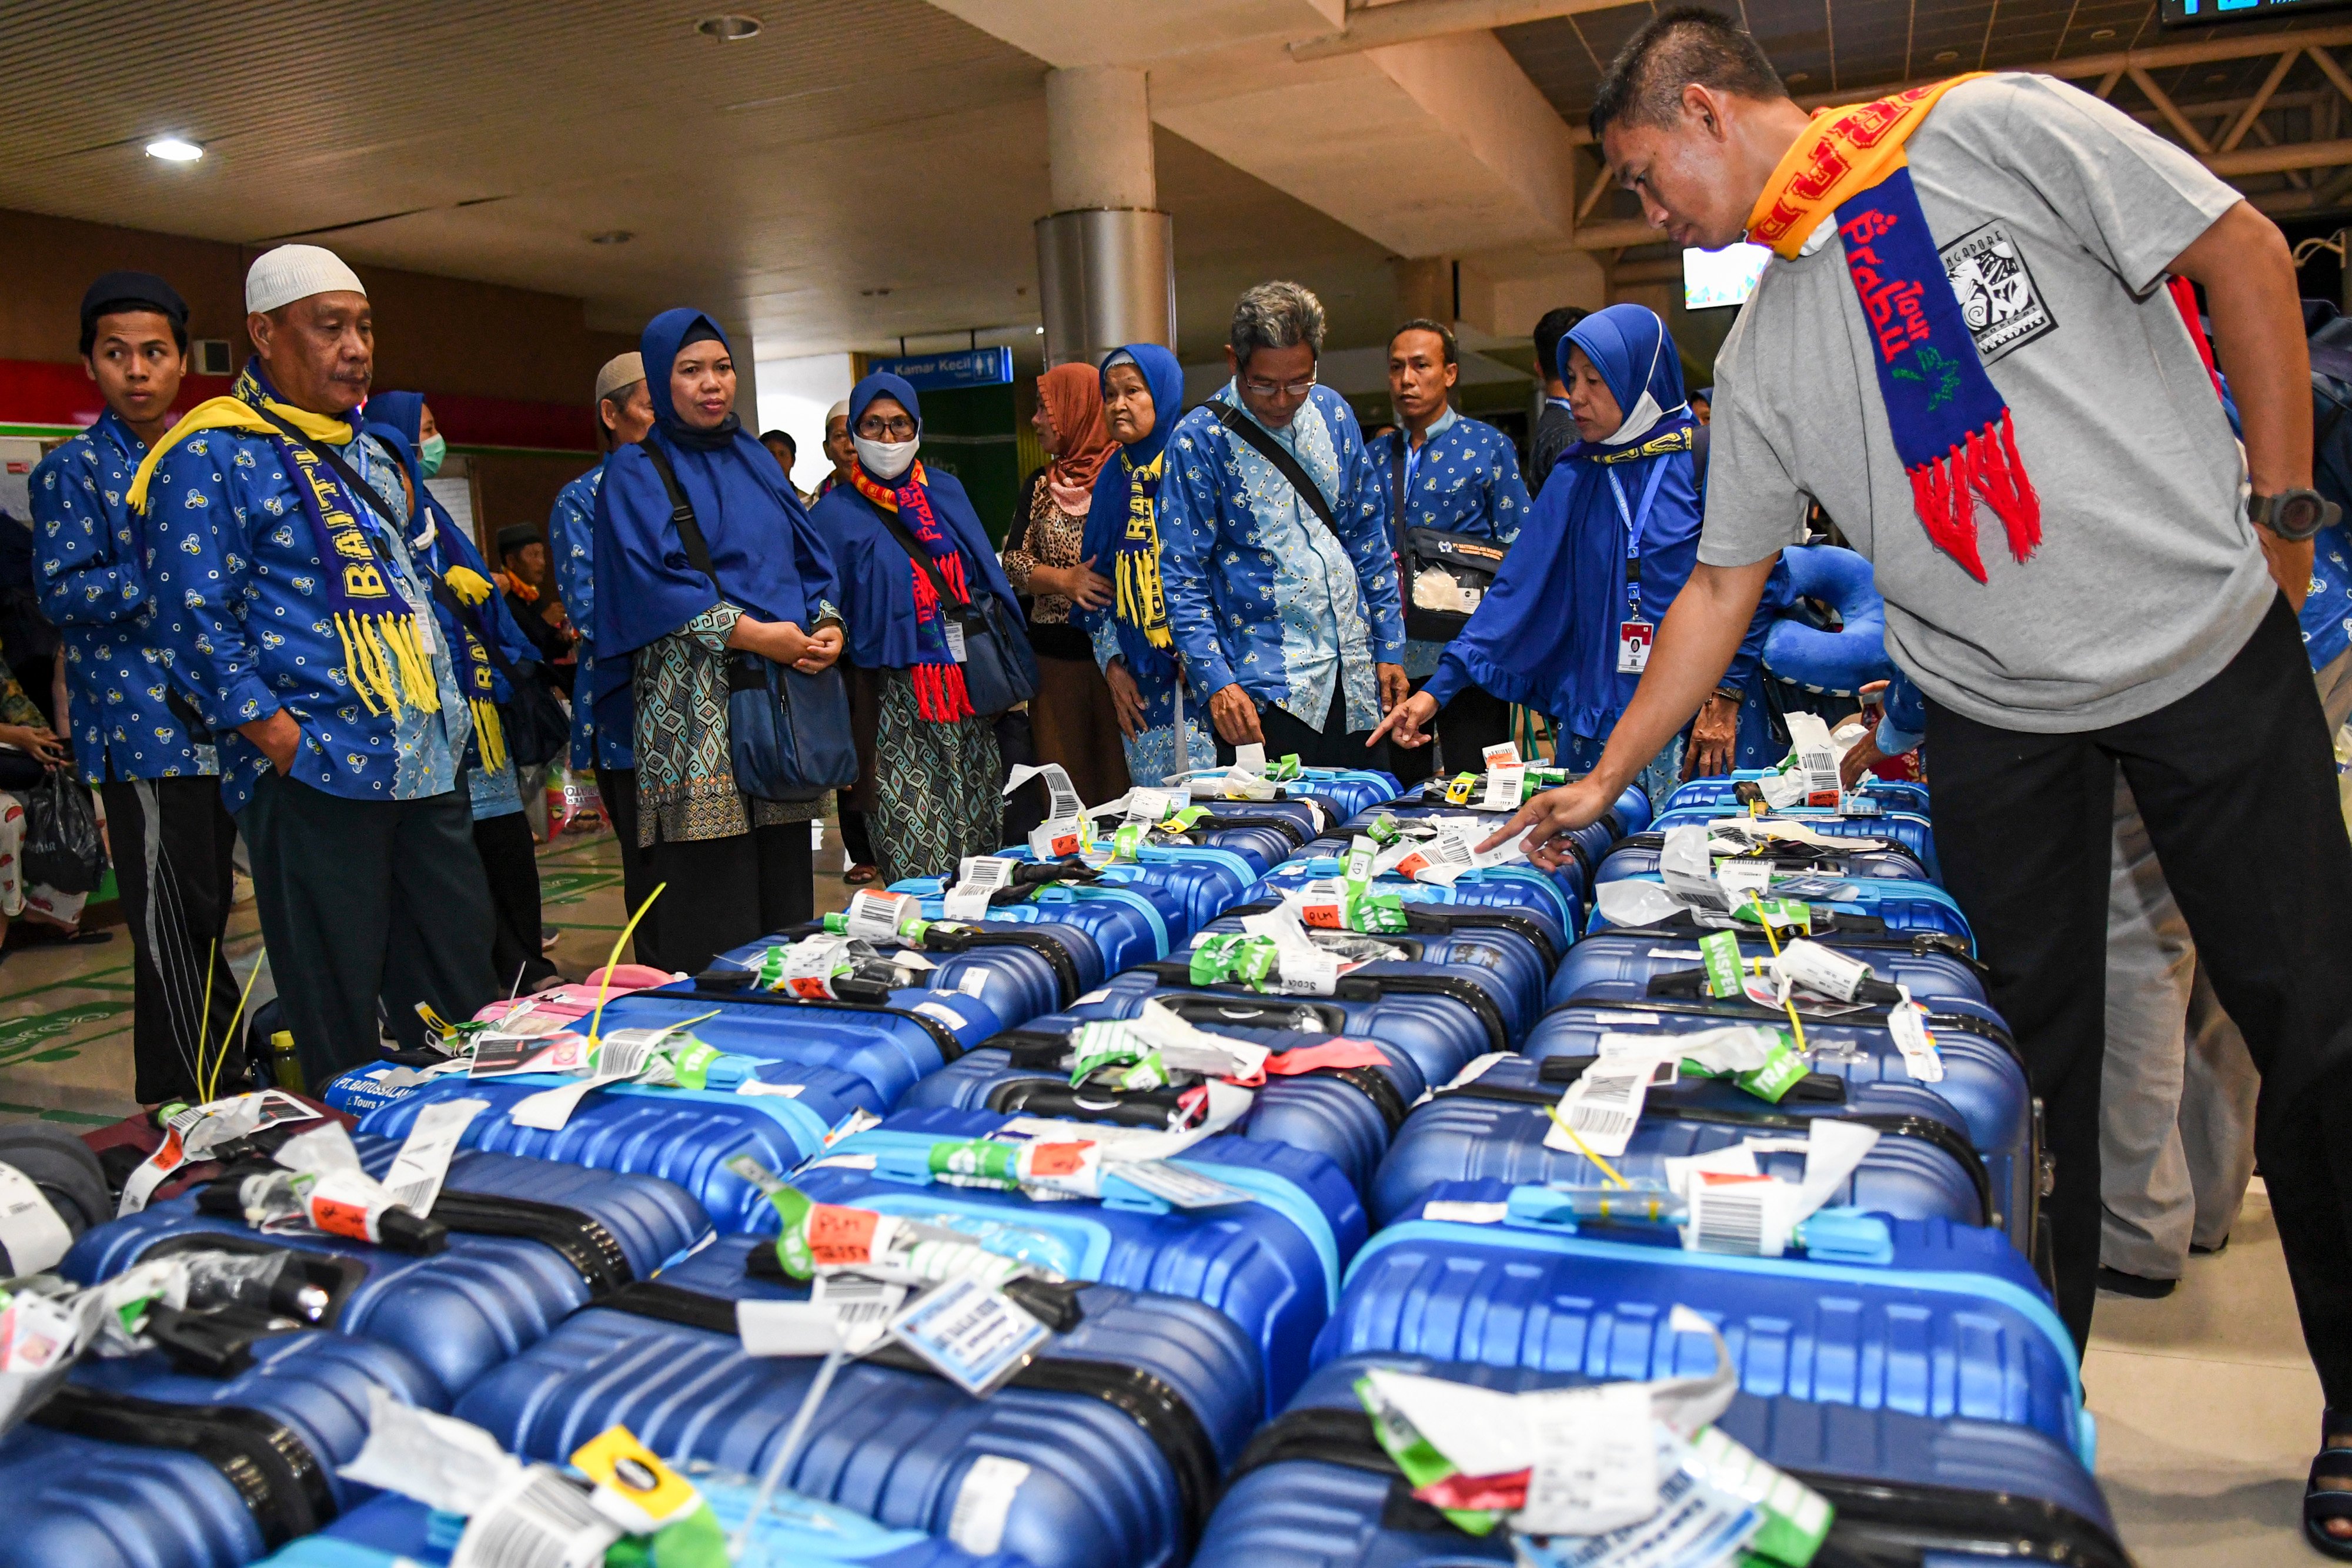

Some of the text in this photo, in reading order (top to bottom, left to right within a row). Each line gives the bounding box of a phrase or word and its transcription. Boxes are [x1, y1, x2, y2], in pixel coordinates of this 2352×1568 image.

[1945, 230, 2003, 268] NGAPORE
[1839, 208, 1910, 364] Prabu
[1893, 280, 1930, 341] Tour
[894, 357, 970, 376] Kamar Kecil
[564, 785, 600, 798] OTATO
[1709, 935, 1738, 997] ANSFER
[335, 1078, 351, 1089] PT.
[353, 1095, 377, 1109] Tours
